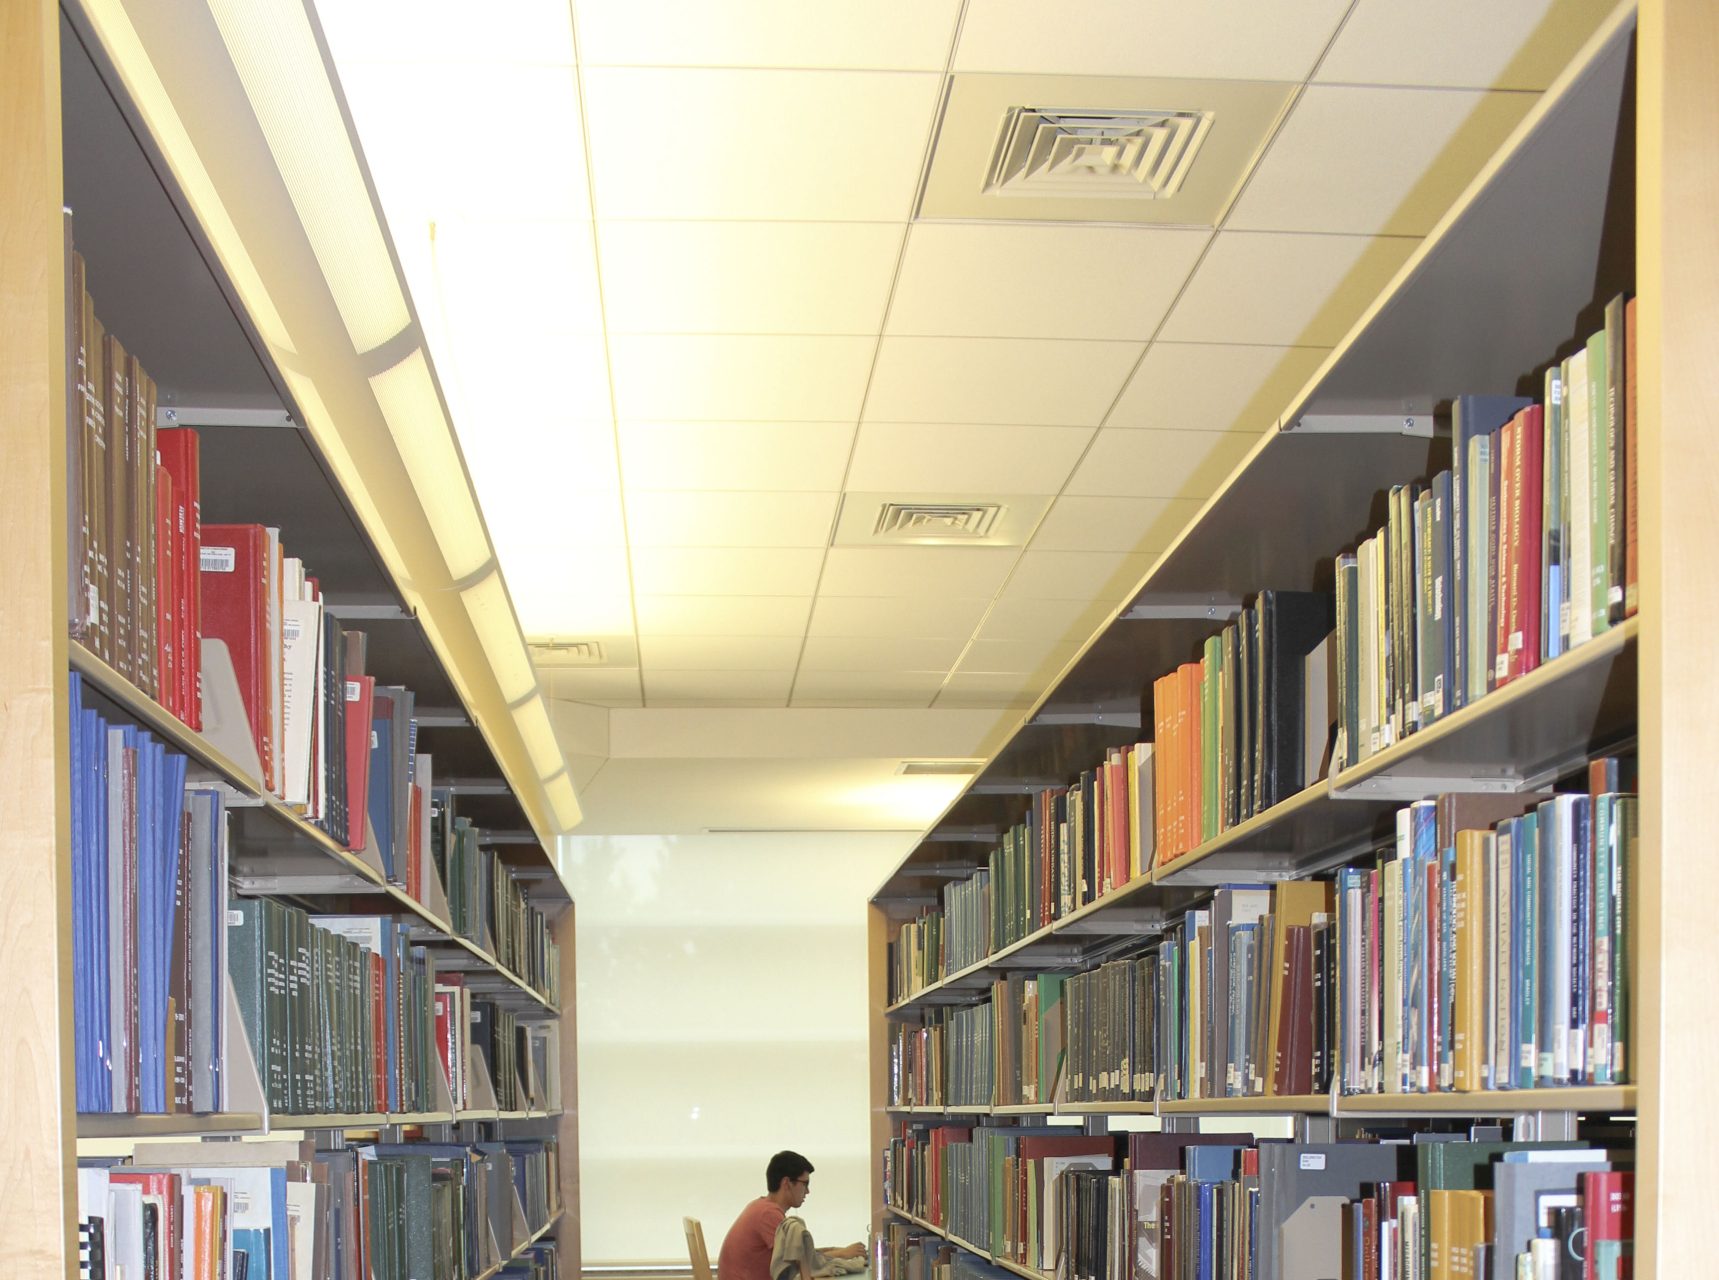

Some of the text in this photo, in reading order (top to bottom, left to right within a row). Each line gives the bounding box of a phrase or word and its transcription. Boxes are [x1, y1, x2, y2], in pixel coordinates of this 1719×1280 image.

[1514, 426, 1522, 462] STORM
[1498, 978, 1506, 1052] NATION
[1363, 1235, 1371, 1280] Online
